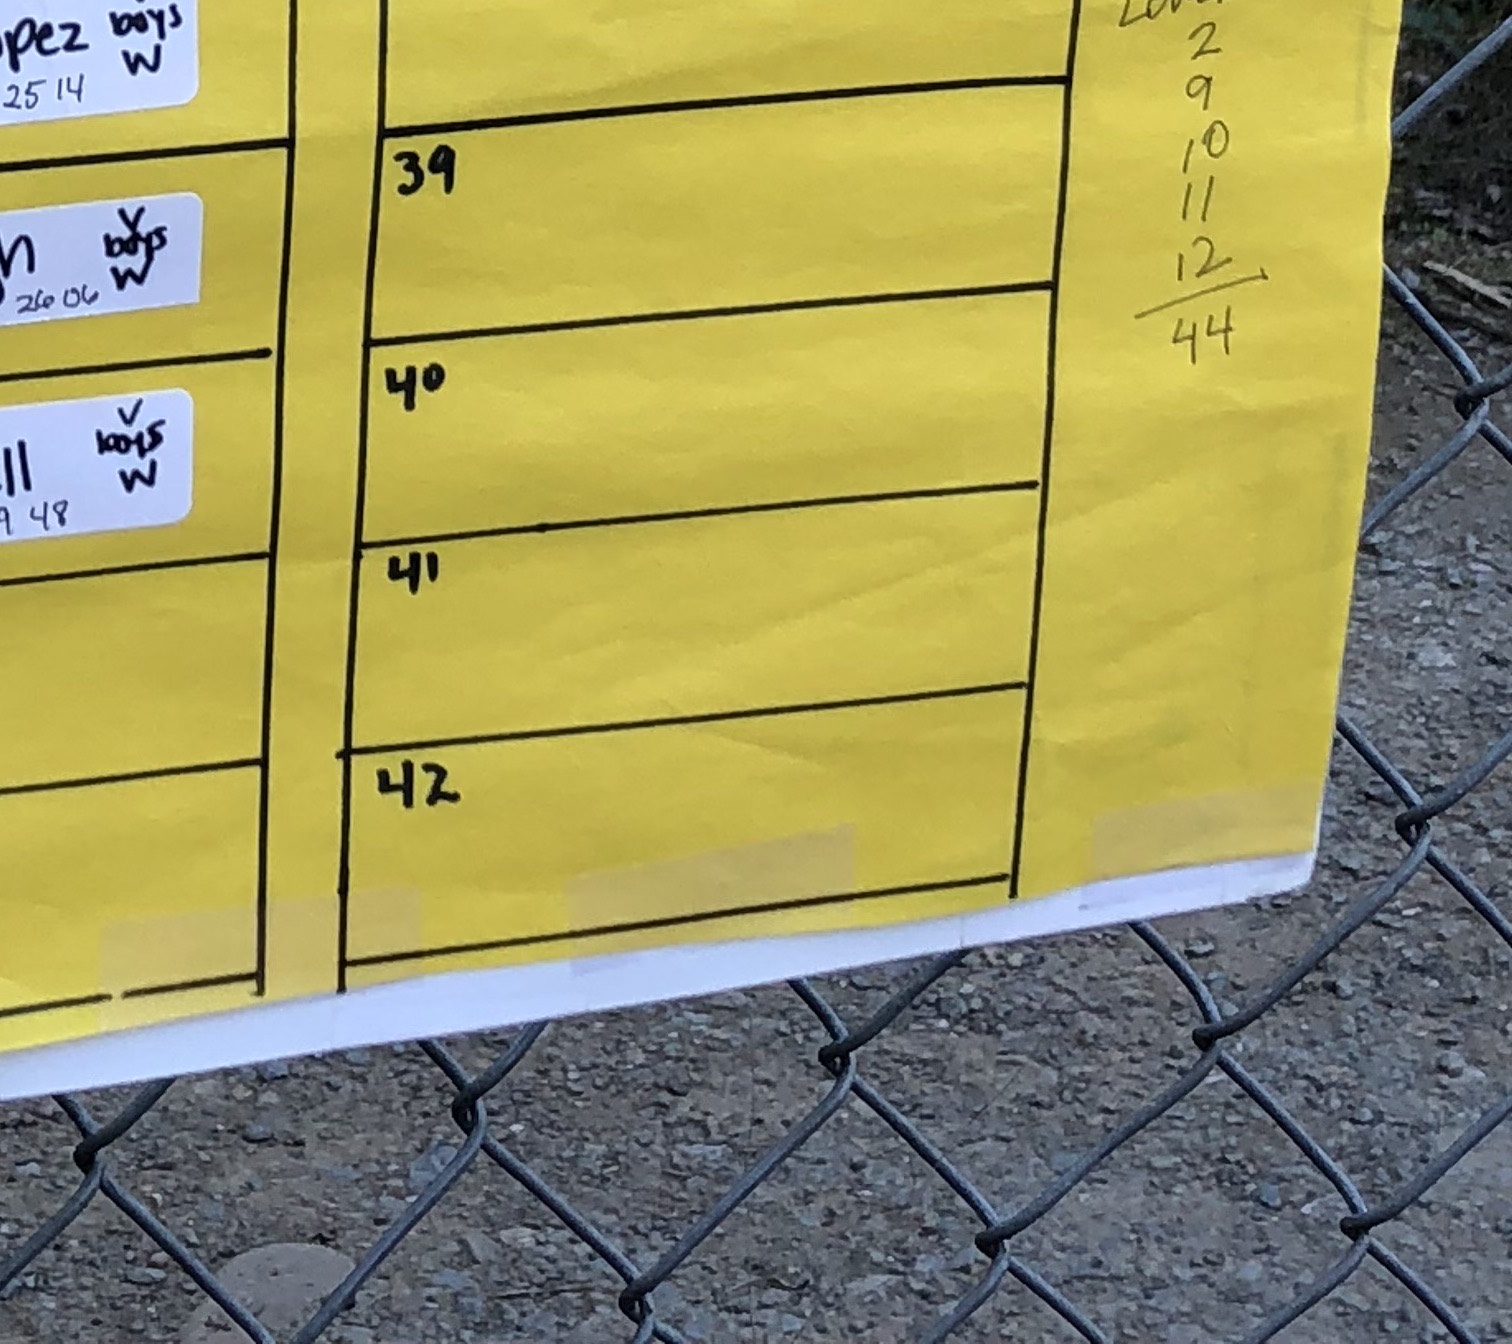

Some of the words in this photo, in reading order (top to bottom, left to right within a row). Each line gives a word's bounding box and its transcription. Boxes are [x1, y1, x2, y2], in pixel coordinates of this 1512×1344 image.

[121, 43, 162, 77] W
[1188, 21, 1222, 60] 2
[1185, 74, 1213, 111] 9
[392, 146, 456, 197] 39
[1182, 119, 1229, 175] 10
[1182, 175, 1215, 223] 11
[1177, 236, 1239, 289] 12
[1172, 305, 1235, 365] 44
[384, 362, 446, 412] 40
[387, 550, 439, 596] 41
[376, 758, 461, 811] 42
